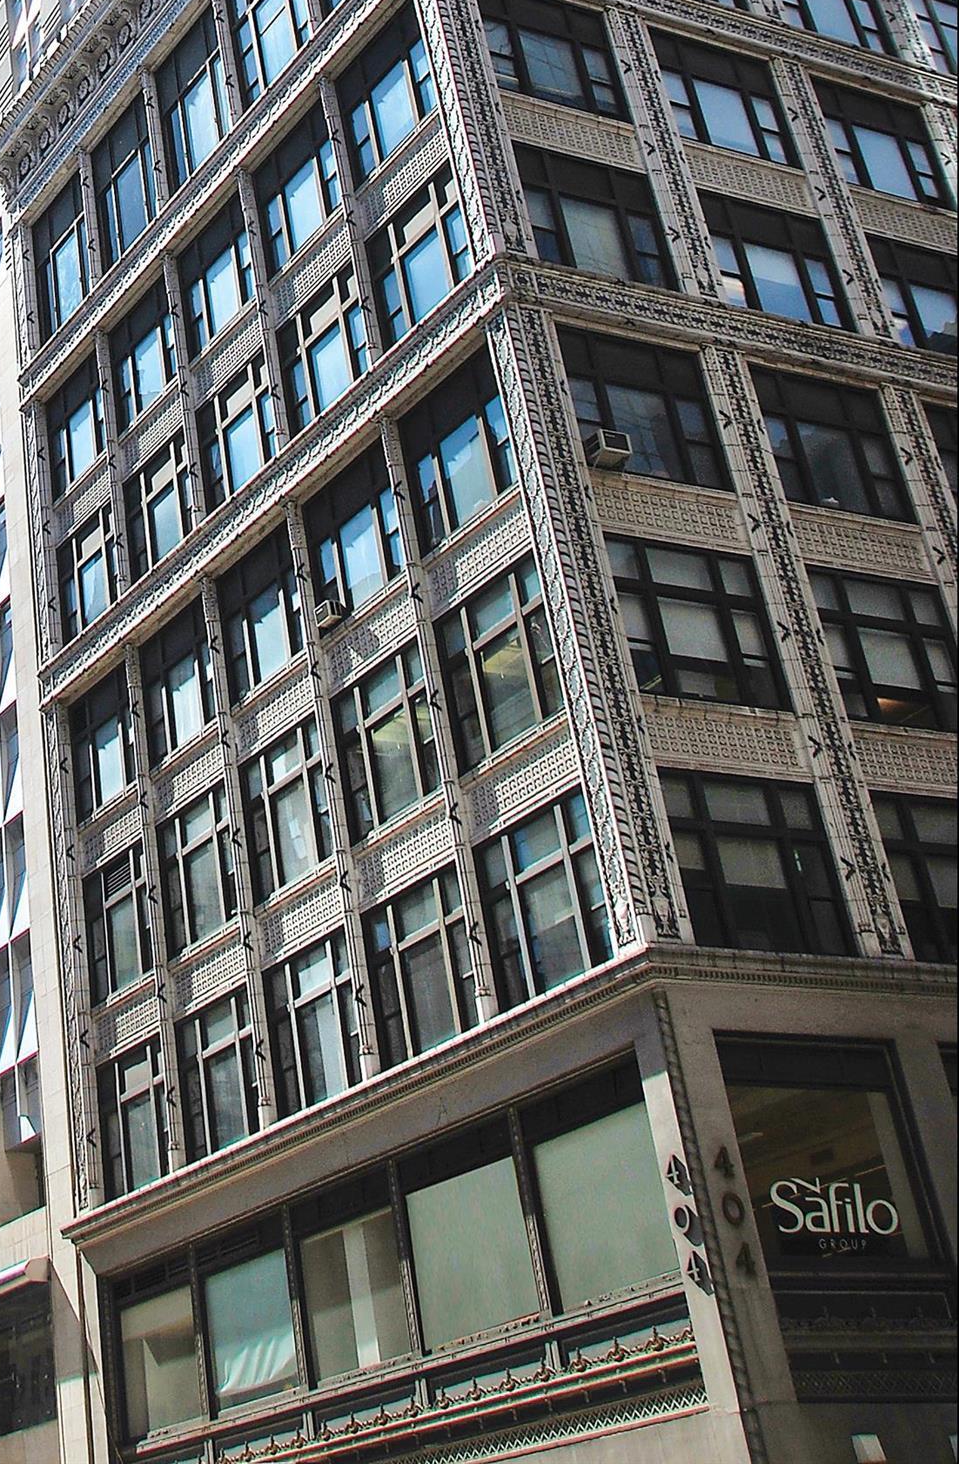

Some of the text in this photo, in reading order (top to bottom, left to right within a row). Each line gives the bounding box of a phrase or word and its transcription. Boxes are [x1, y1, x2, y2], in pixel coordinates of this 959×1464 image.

[666, 1155, 700, 1281] 404
[714, 1145, 757, 1280] 404
[770, 1177, 899, 1235] Safilo
[818, 1238, 867, 1250] GROUP
